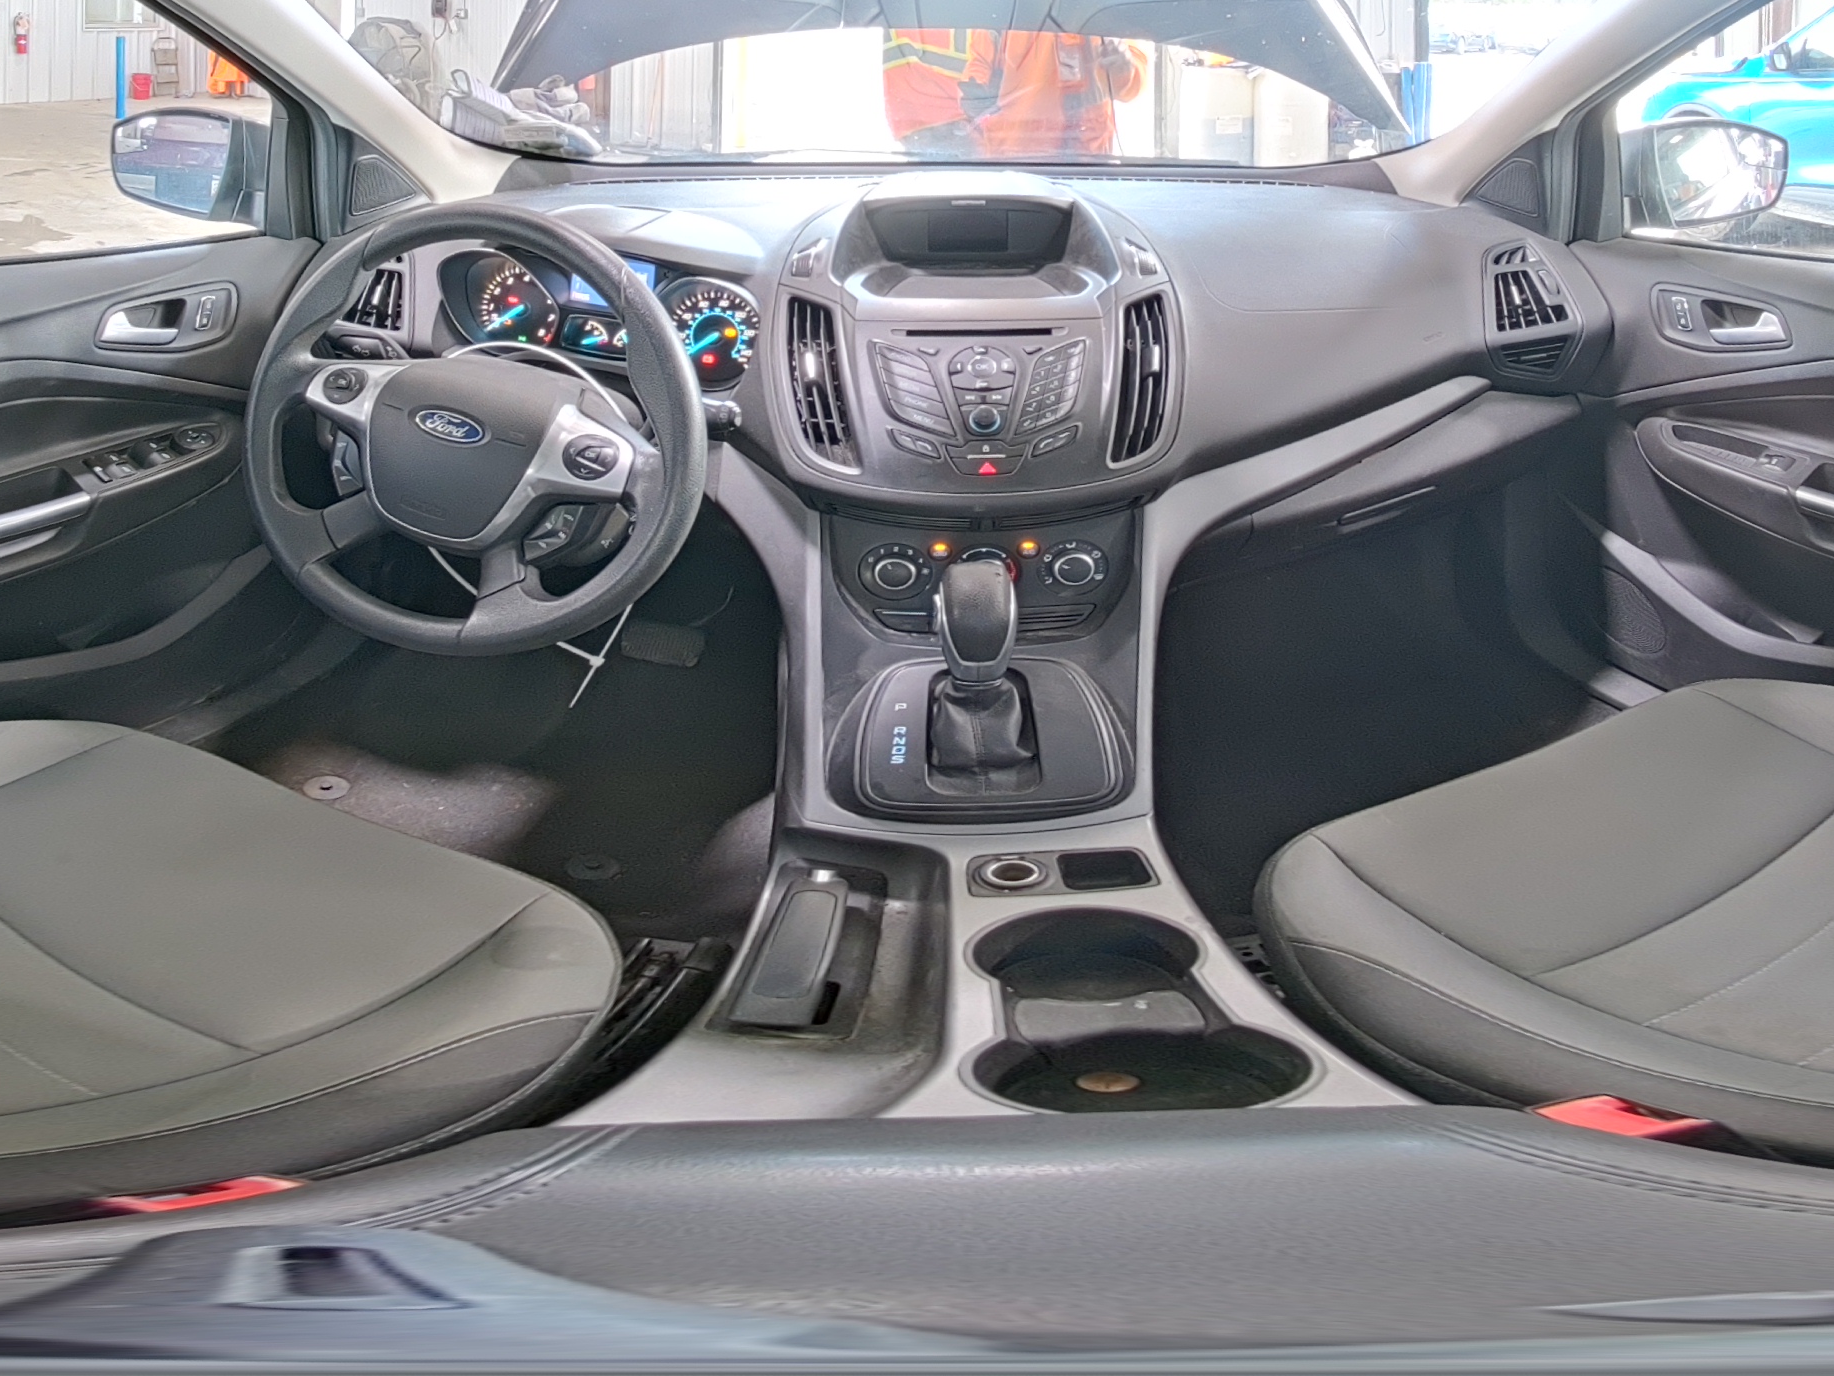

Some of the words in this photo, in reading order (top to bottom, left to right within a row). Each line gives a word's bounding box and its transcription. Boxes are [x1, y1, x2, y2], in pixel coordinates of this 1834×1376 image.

[425, 414, 470, 437] Ford
[894, 703, 908, 711] P
[893, 726, 907, 735] R
[892, 736, 906, 745] N
[891, 746, 906, 755] D
[890, 755, 906, 764] S
